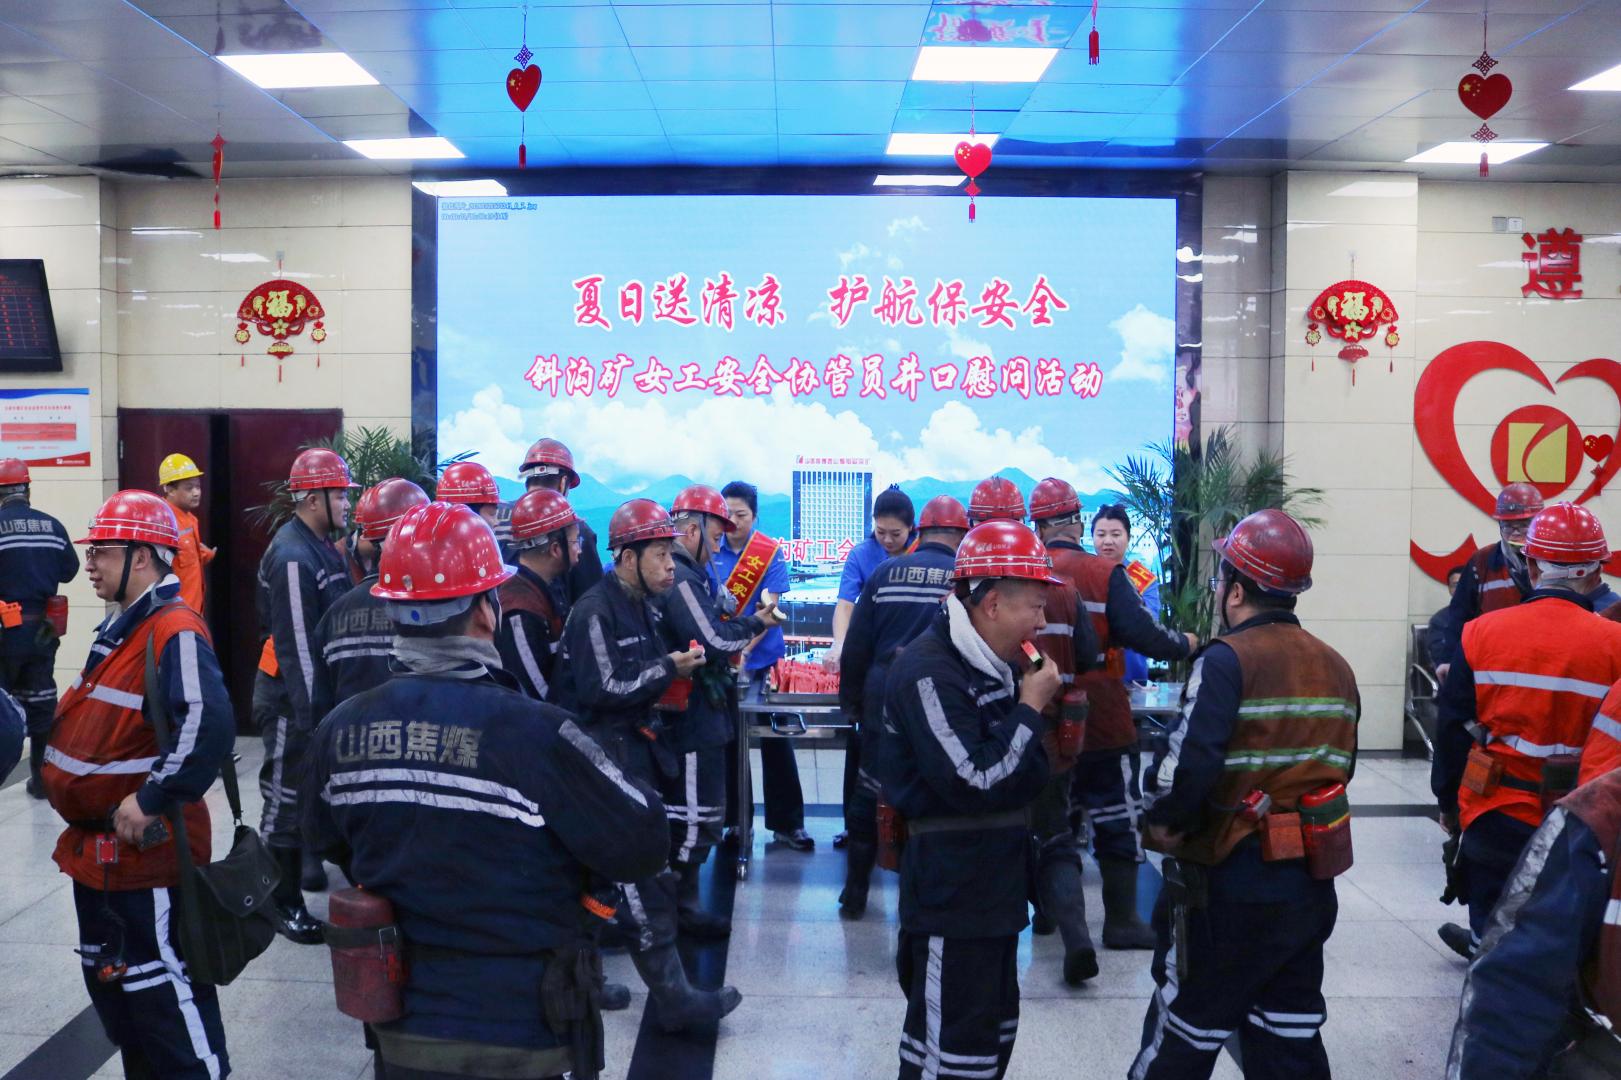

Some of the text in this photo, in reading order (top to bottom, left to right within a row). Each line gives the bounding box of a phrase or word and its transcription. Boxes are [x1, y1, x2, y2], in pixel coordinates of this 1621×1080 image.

[1521, 227, 1583, 299] 遵
[574, 273, 1068, 330] 夏日送清凉 护航保安全
[1341, 292, 1369, 321] 福
[331, 607, 394, 635] 山西焦
[336, 720, 482, 768] 山西焦煤
